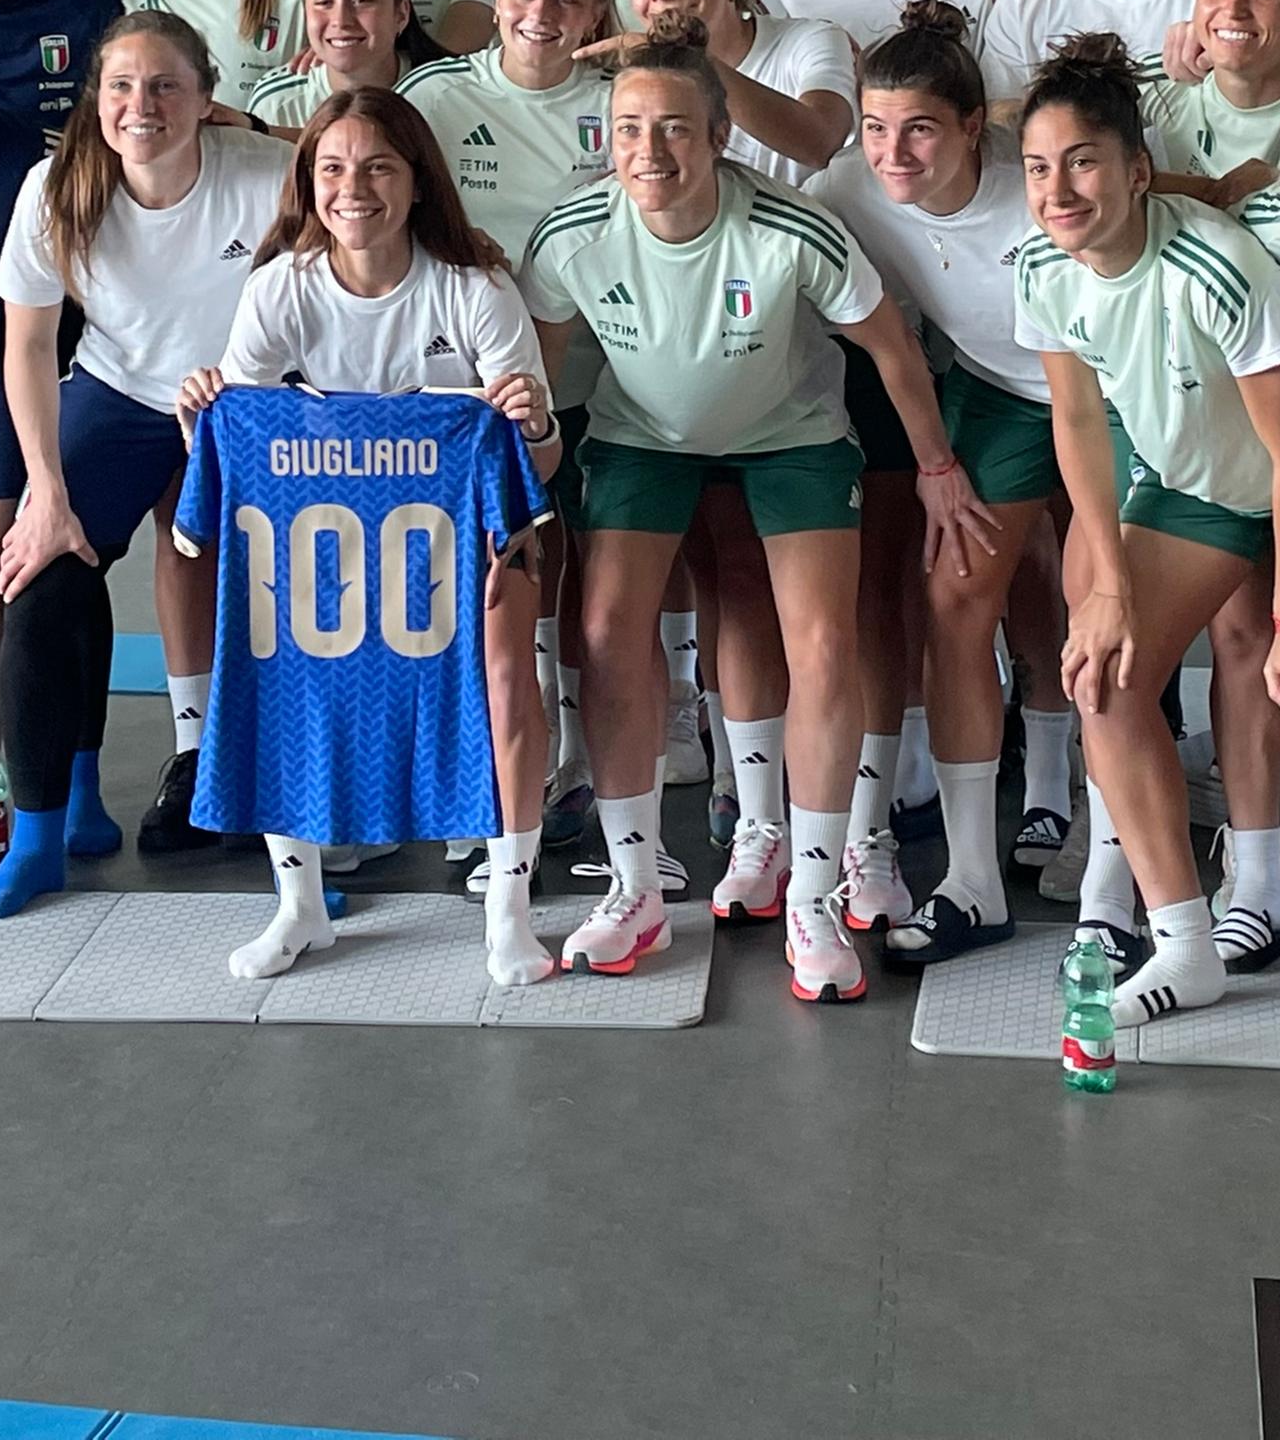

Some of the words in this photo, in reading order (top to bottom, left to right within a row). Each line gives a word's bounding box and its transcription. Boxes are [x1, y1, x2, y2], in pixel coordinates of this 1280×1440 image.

[474, 160, 499, 172] TIM
[460, 175, 497, 190] Poste
[612, 322, 639, 338] TIM
[599, 332, 639, 352] Poste
[723, 346, 747, 358] eni
[270, 439, 438, 476] GIUGLIANO
[235, 502, 457, 659] 100
